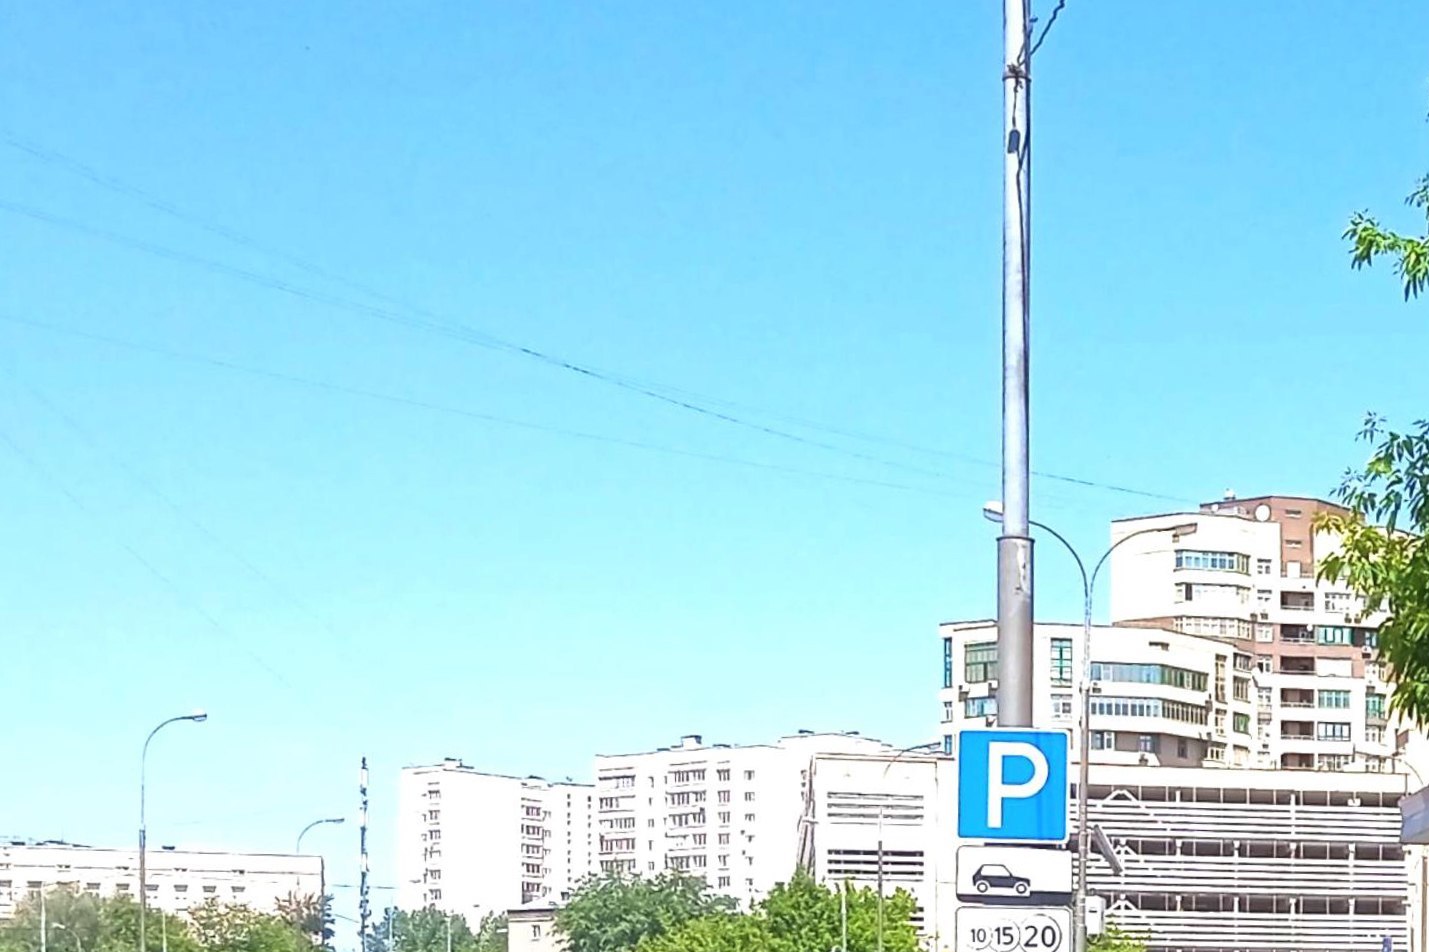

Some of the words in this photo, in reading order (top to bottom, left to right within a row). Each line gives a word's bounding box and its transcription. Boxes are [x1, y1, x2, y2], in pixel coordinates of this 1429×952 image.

[987, 741, 1049, 828] P
[971, 928, 987, 943] 10
[994, 926, 1015, 945] 15
[1024, 925, 1057, 948] 20
